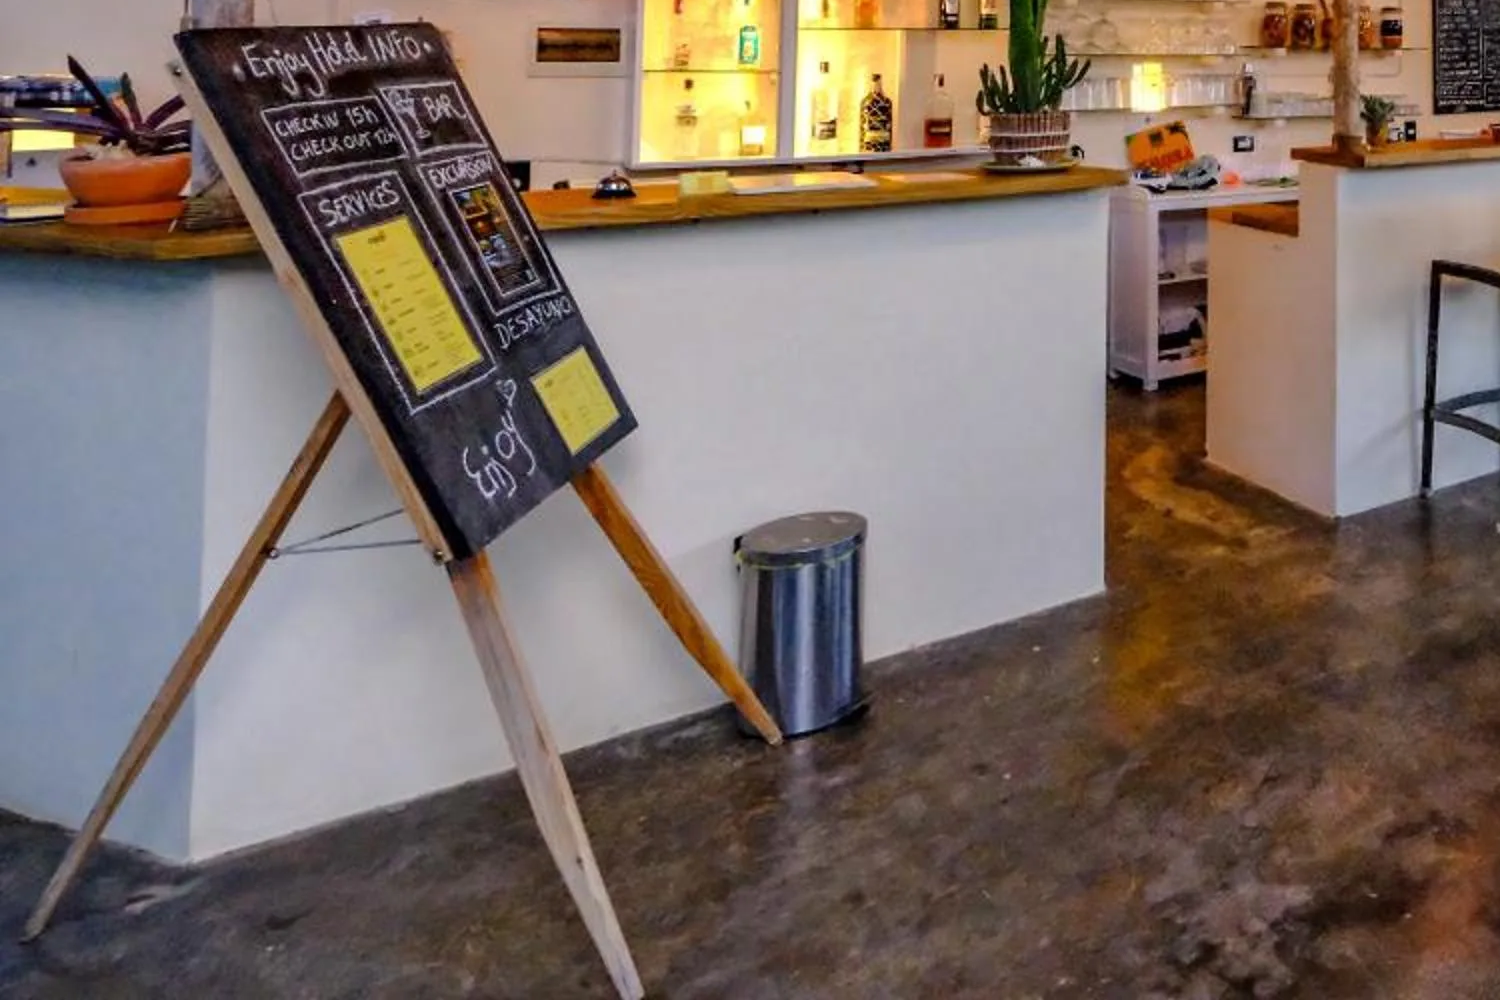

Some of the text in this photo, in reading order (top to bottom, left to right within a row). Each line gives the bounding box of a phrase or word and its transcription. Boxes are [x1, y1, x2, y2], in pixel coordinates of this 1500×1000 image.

[240, 40, 325, 97] Enjoy
[304, 31, 367, 74] Hotel
[275, 115, 324, 138] CHECK
[421, 93, 467, 123] BAR
[290, 135, 344, 161] CHECK
[343, 131, 371, 150] OUT
[318, 180, 400, 227] SERVICES
[493, 295, 575, 349] DESAYUNO
[463, 409, 536, 499] Enjoy
